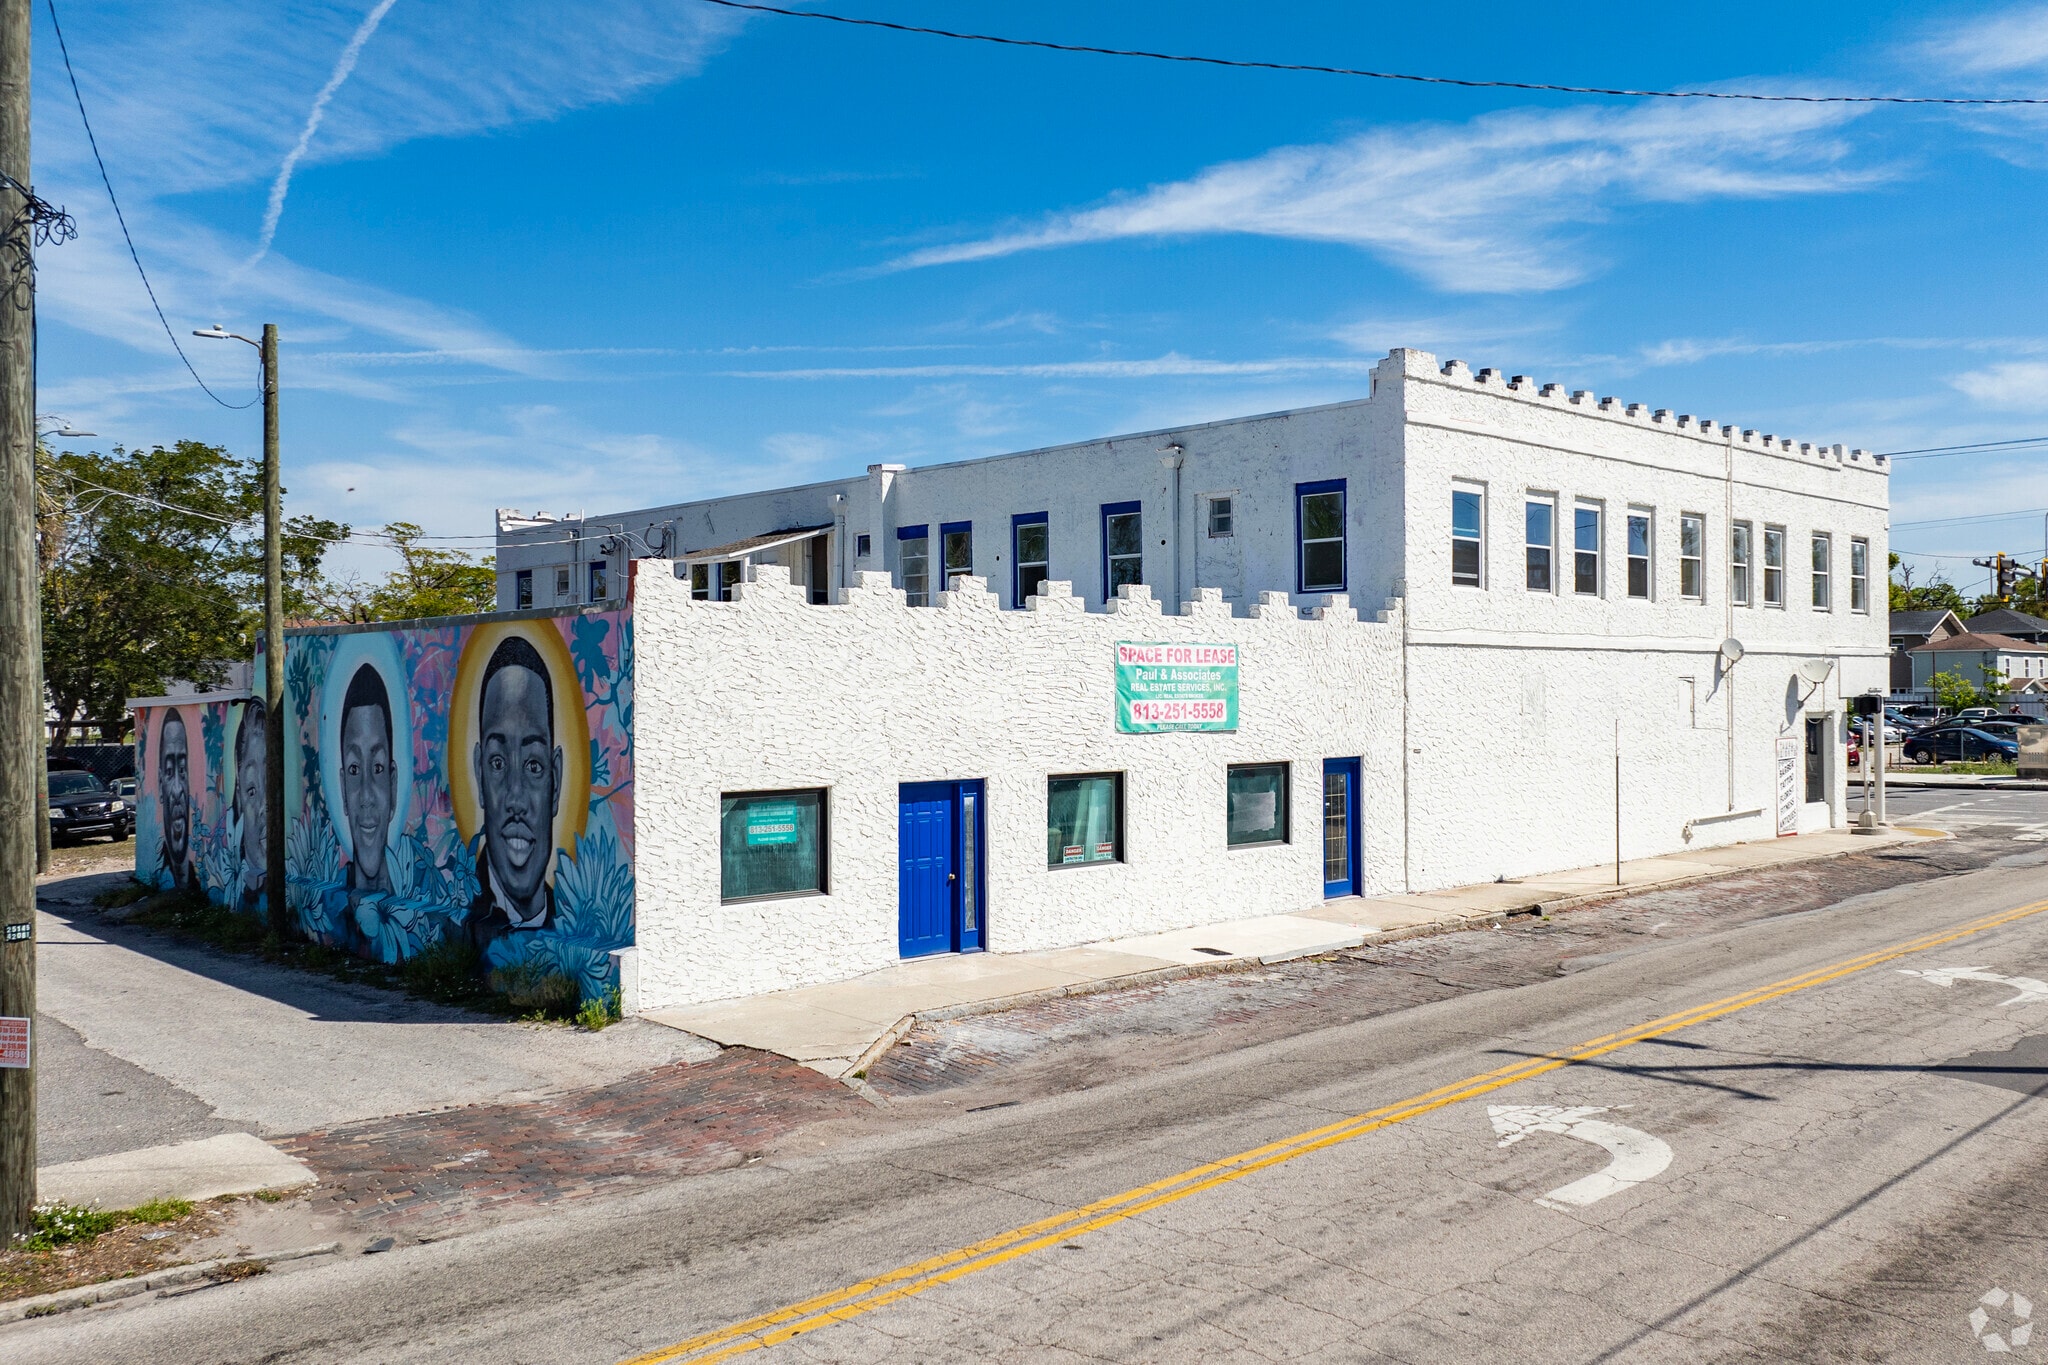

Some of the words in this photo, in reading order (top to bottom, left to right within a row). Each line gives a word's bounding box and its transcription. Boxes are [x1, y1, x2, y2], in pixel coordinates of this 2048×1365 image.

[1119, 647, 1162, 662] SPACE
[1166, 648, 1192, 663] FOR
[1196, 648, 1235, 664] LEASE
[1136, 668, 1157, 680] Paul
[1160, 668, 1167, 680] &
[1170, 669, 1221, 680] Associates
[1131, 683, 1148, 692] REAL
[1150, 683, 1176, 692] ESTATE
[1133, 702, 1224, 720] 813-251-5558
